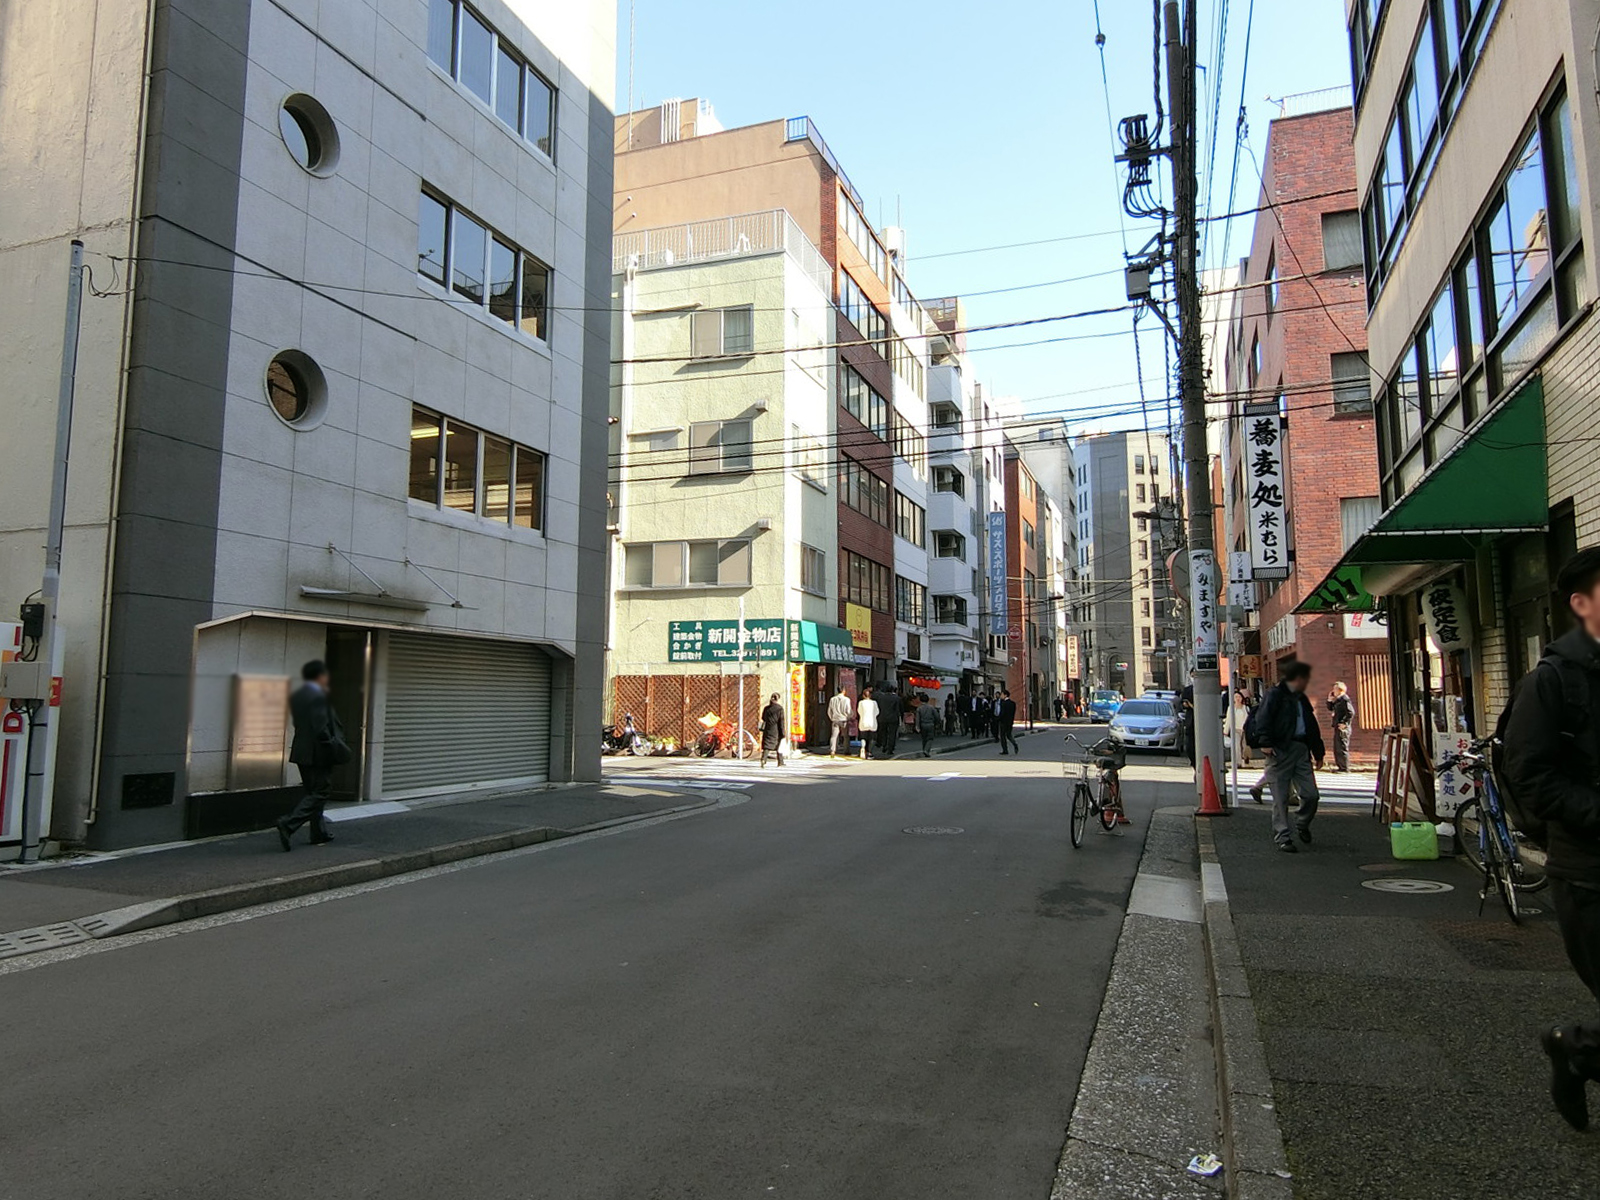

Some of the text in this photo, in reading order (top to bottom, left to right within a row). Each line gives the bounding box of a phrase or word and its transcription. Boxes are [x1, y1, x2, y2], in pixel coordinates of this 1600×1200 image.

[1249, 418, 1283, 565] 蕎麦処 米むら
[1197, 572, 1213, 634] みますや
[1429, 589, 1461, 643] 夜定食
[707, 627, 782, 644] 新開金物店
[790, 623, 799, 659] 新開金物
[1441, 749, 1456, 796] お事処
